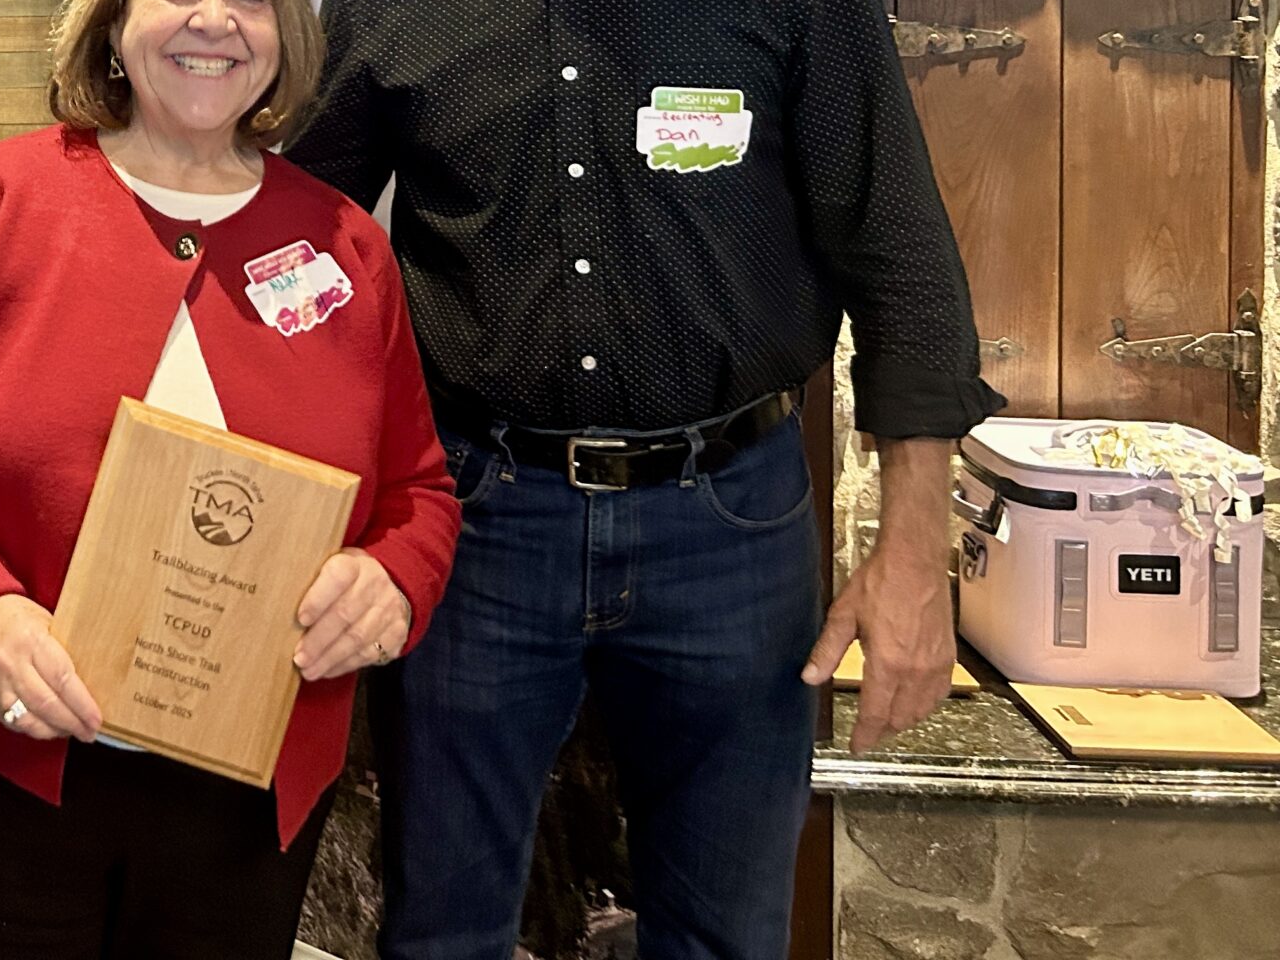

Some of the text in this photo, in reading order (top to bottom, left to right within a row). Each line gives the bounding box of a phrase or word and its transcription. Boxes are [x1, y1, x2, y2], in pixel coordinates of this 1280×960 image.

[655, 128, 700, 142] Dan
[189, 485, 255, 524] TMA
[152, 549, 258, 595] Trailblazing Award
[1126, 566, 1172, 582] YETI
[163, 612, 212, 639] TCPUD
[134, 635, 222, 675] North Shore Trail
[134, 655, 211, 692] Reconstruction
[133, 691, 169, 712] October
